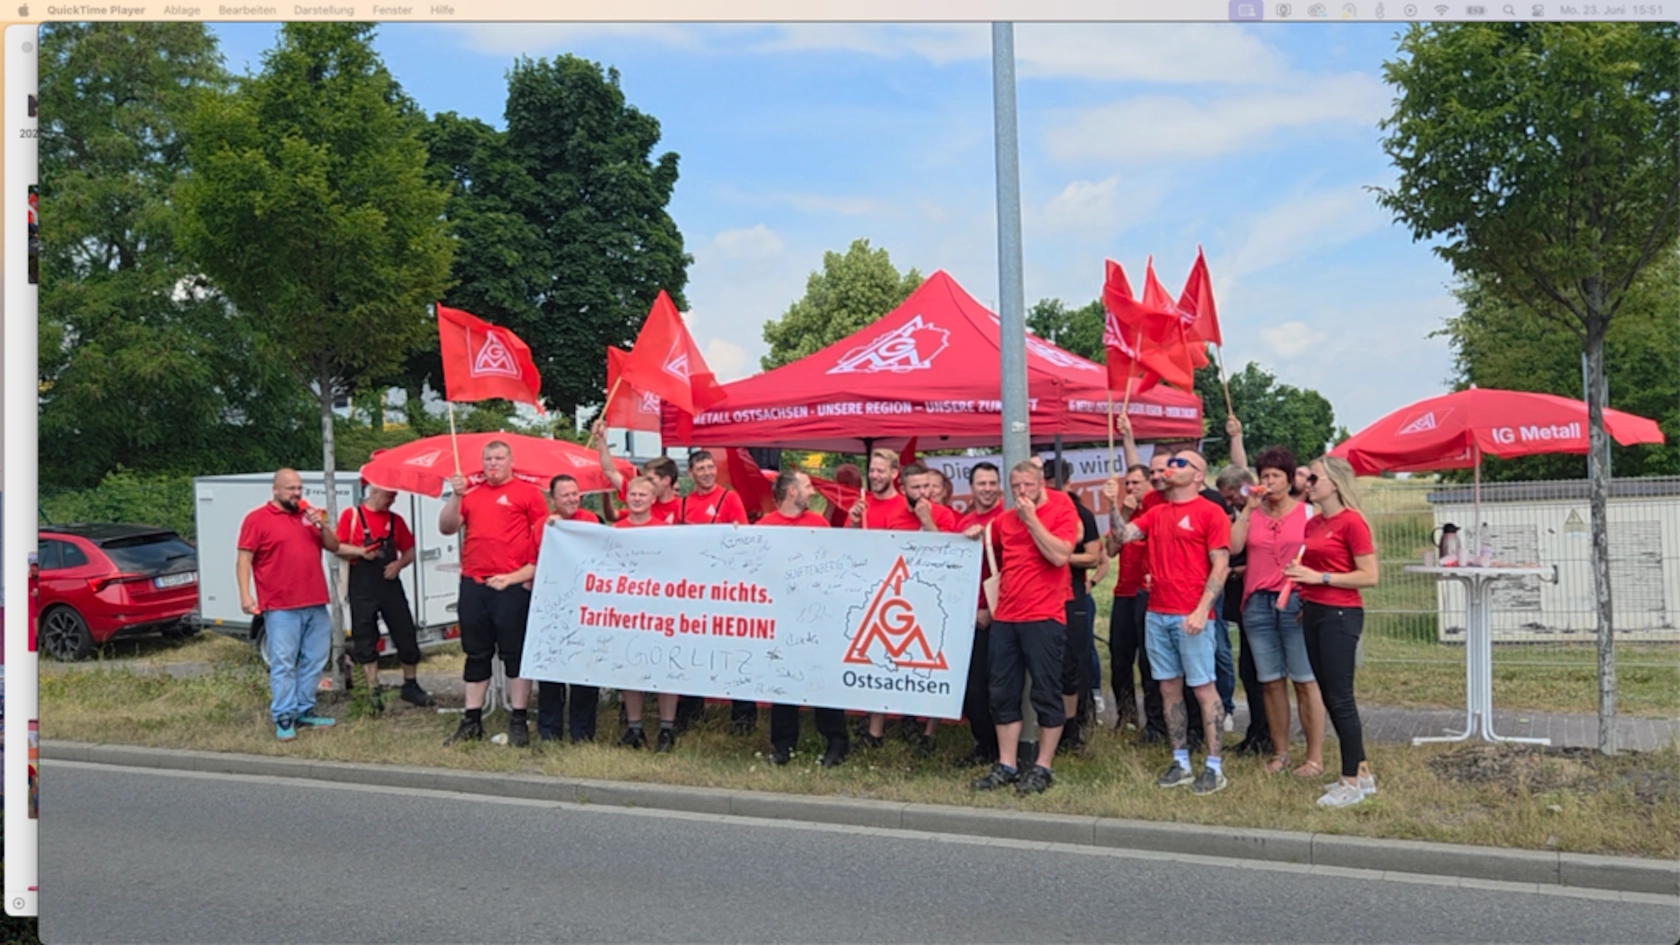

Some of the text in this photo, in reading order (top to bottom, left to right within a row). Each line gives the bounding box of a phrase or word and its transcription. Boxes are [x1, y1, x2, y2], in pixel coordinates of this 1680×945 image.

[47, 5, 146, 17] QuickTime Player
[163, 5, 201, 17] Ablage
[219, 4, 276, 16] Bearbeiten
[294, 4, 355, 17] Darstellung
[372, 4, 413, 16] Fenster
[430, 4, 455, 16] Hilfe
[1560, 4, 1663, 15] Mo. 23. Juni 15:51
[733, 406, 808, 422] OSTSACHSEN
[817, 402, 863, 416] UNSERE
[865, 401, 912, 415] REGION
[925, 400, 976, 413] UNSERE
[1492, 422, 1581, 444] IG Metall
[1079, 455, 1123, 474] wird
[585, 573, 613, 594] Das
[616, 576, 661, 597] Beste
[664, 578, 706, 600] oder
[710, 580, 773, 604] nichts.
[579, 606, 776, 640] Tarifvertrag bei HEDIN!
[843, 670, 950, 695] Ostsachsen
